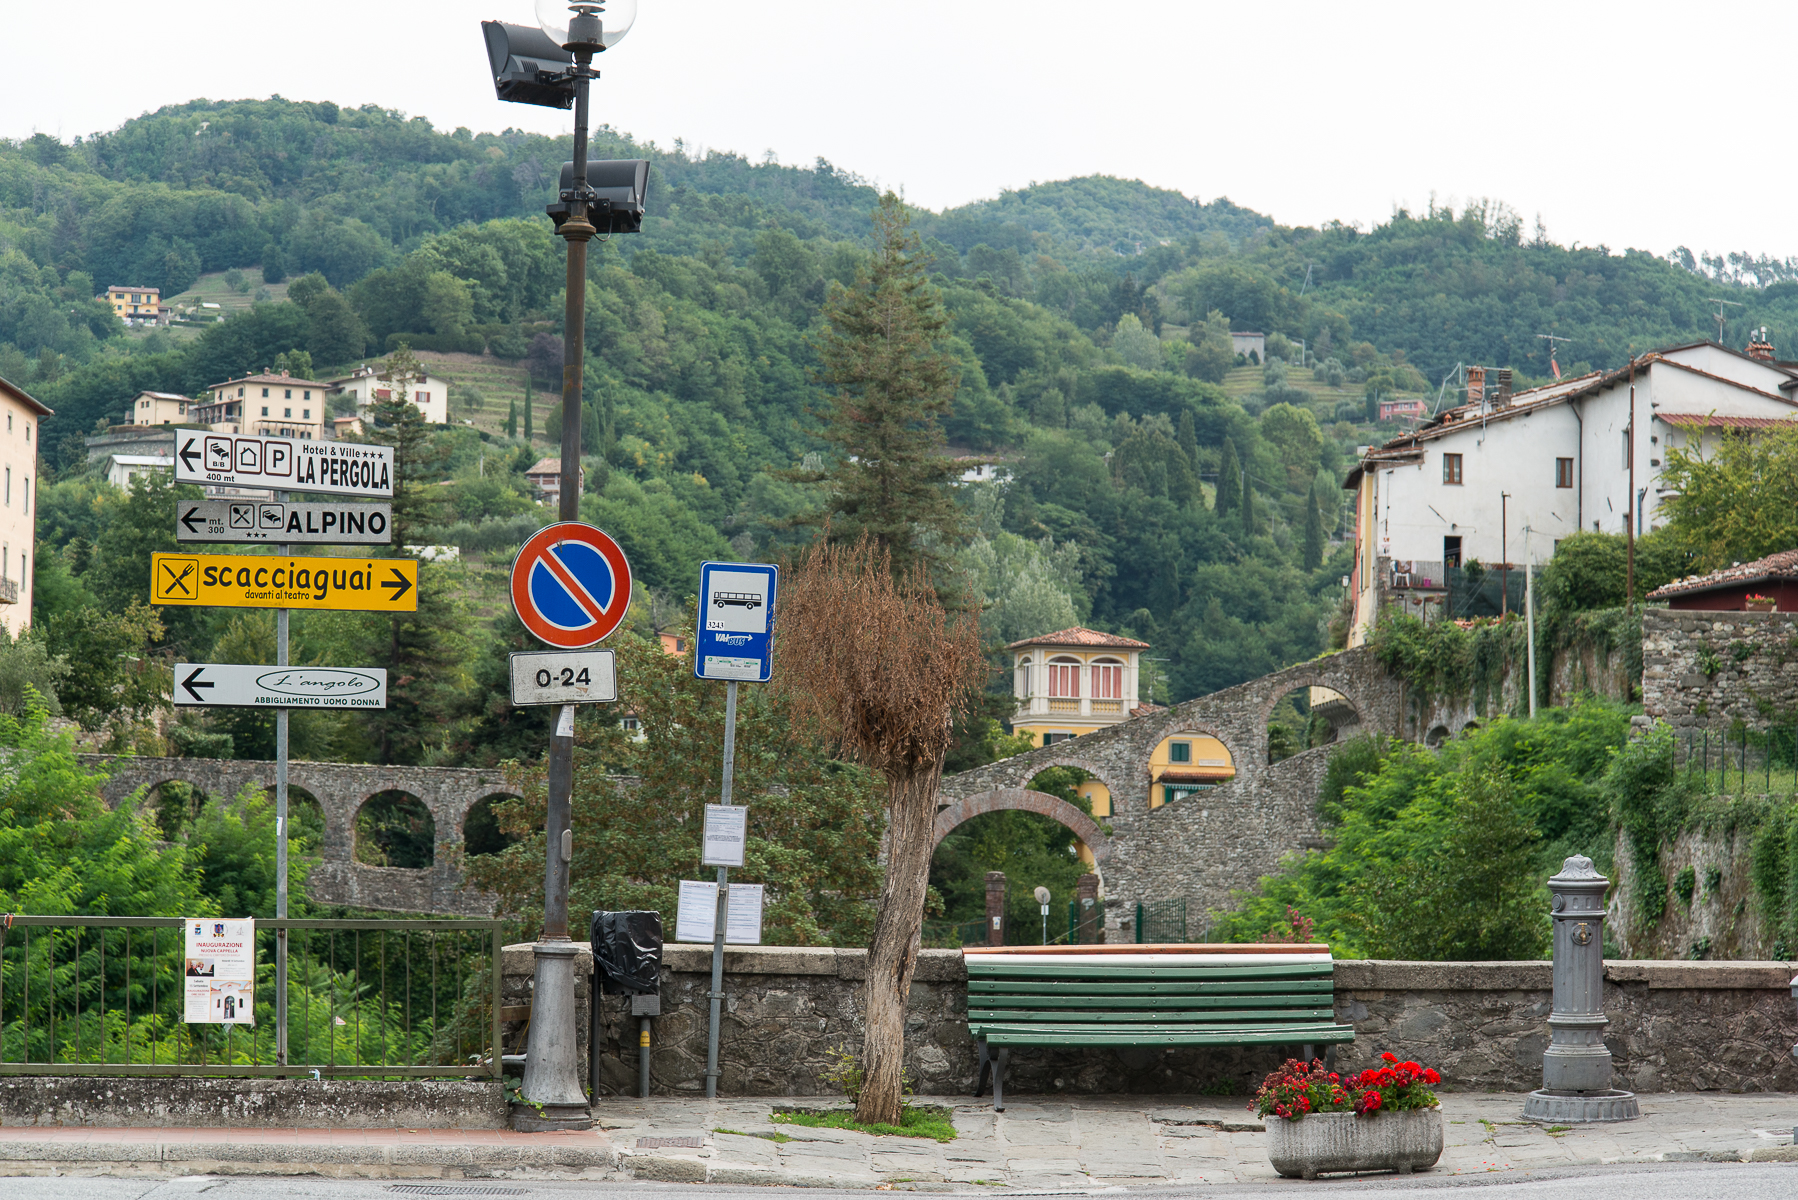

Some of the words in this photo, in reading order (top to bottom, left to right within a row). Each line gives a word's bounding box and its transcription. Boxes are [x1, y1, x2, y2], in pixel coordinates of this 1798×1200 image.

[303, 444, 327, 456] Hotel
[330, 446, 337, 456] &
[339, 447, 361, 458] Ville
[212, 460, 225, 468] B/B
[272, 450, 285, 468] P
[206, 473, 221, 482] 400
[223, 474, 235, 483] mt
[297, 455, 316, 484] LA
[320, 457, 390, 490] PERGOLA
[209, 517, 224, 525] mt.
[285, 511, 386, 534] ALPINO
[208, 526, 225, 534] 300
[203, 561, 373, 601] scacciaguai
[244, 589, 274, 600] davanti
[275, 589, 283, 600] al
[284, 590, 310, 600] teatro
[707, 621, 724, 629] 3243
[273, 675, 364, 690] L'angolo
[536, 667, 592, 688] 0-24
[254, 696, 320, 705] ABBIGLIAMENTO
[323, 698, 348, 706] UOMO
[350, 698, 380, 706] DONNA
